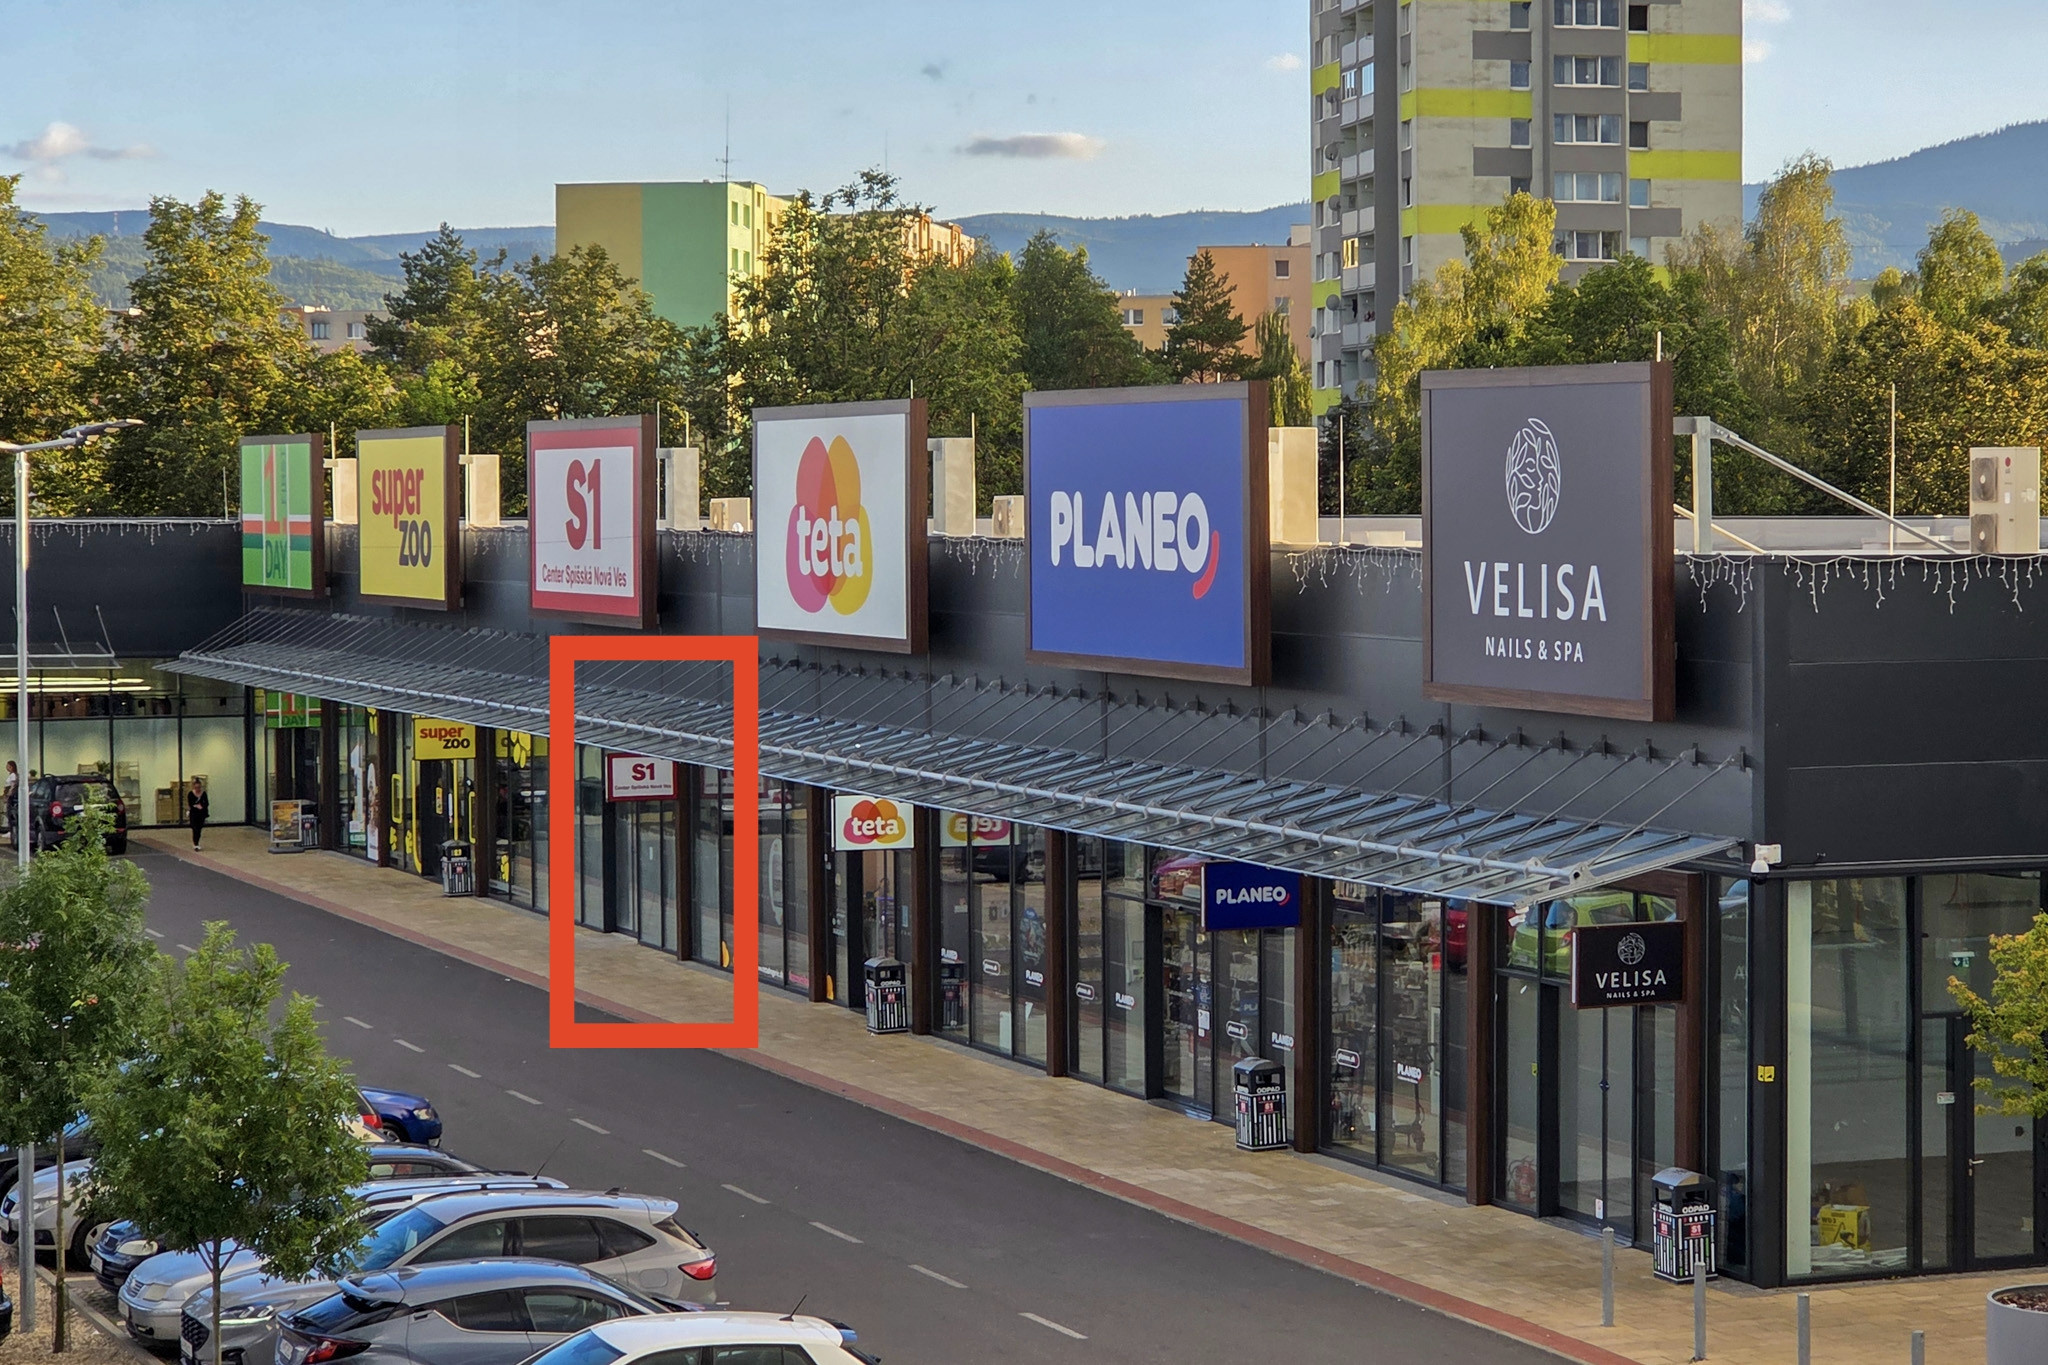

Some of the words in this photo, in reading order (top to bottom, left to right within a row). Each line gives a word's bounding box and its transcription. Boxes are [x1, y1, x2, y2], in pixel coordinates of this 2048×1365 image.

[372, 468, 424, 529] super
[565, 458, 601, 550] S1
[399, 520, 431, 567] zoo
[797, 505, 863, 577] teta
[1051, 491, 1209, 574] PLANEO
[265, 540, 287, 579] DAY
[542, 563, 564, 583] Center
[565, 565, 592, 588] Spišská
[594, 566, 612, 586] Nová
[613, 567, 627, 587] Ves
[1464, 561, 1607, 621] VELISA
[1485, 636, 1532, 659] NAILS
[1538, 640, 1548, 660] &
[1554, 641, 1583, 662] SPA
[420, 727, 464, 741] super
[443, 738, 470, 749] zoo
[632, 763, 655, 781] S1
[852, 817, 899, 836] teta
[1216, 886, 1286, 904] PLANEO
[1595, 969, 1666, 989] VELISA
[1690, 1224, 1702, 1234] S1
